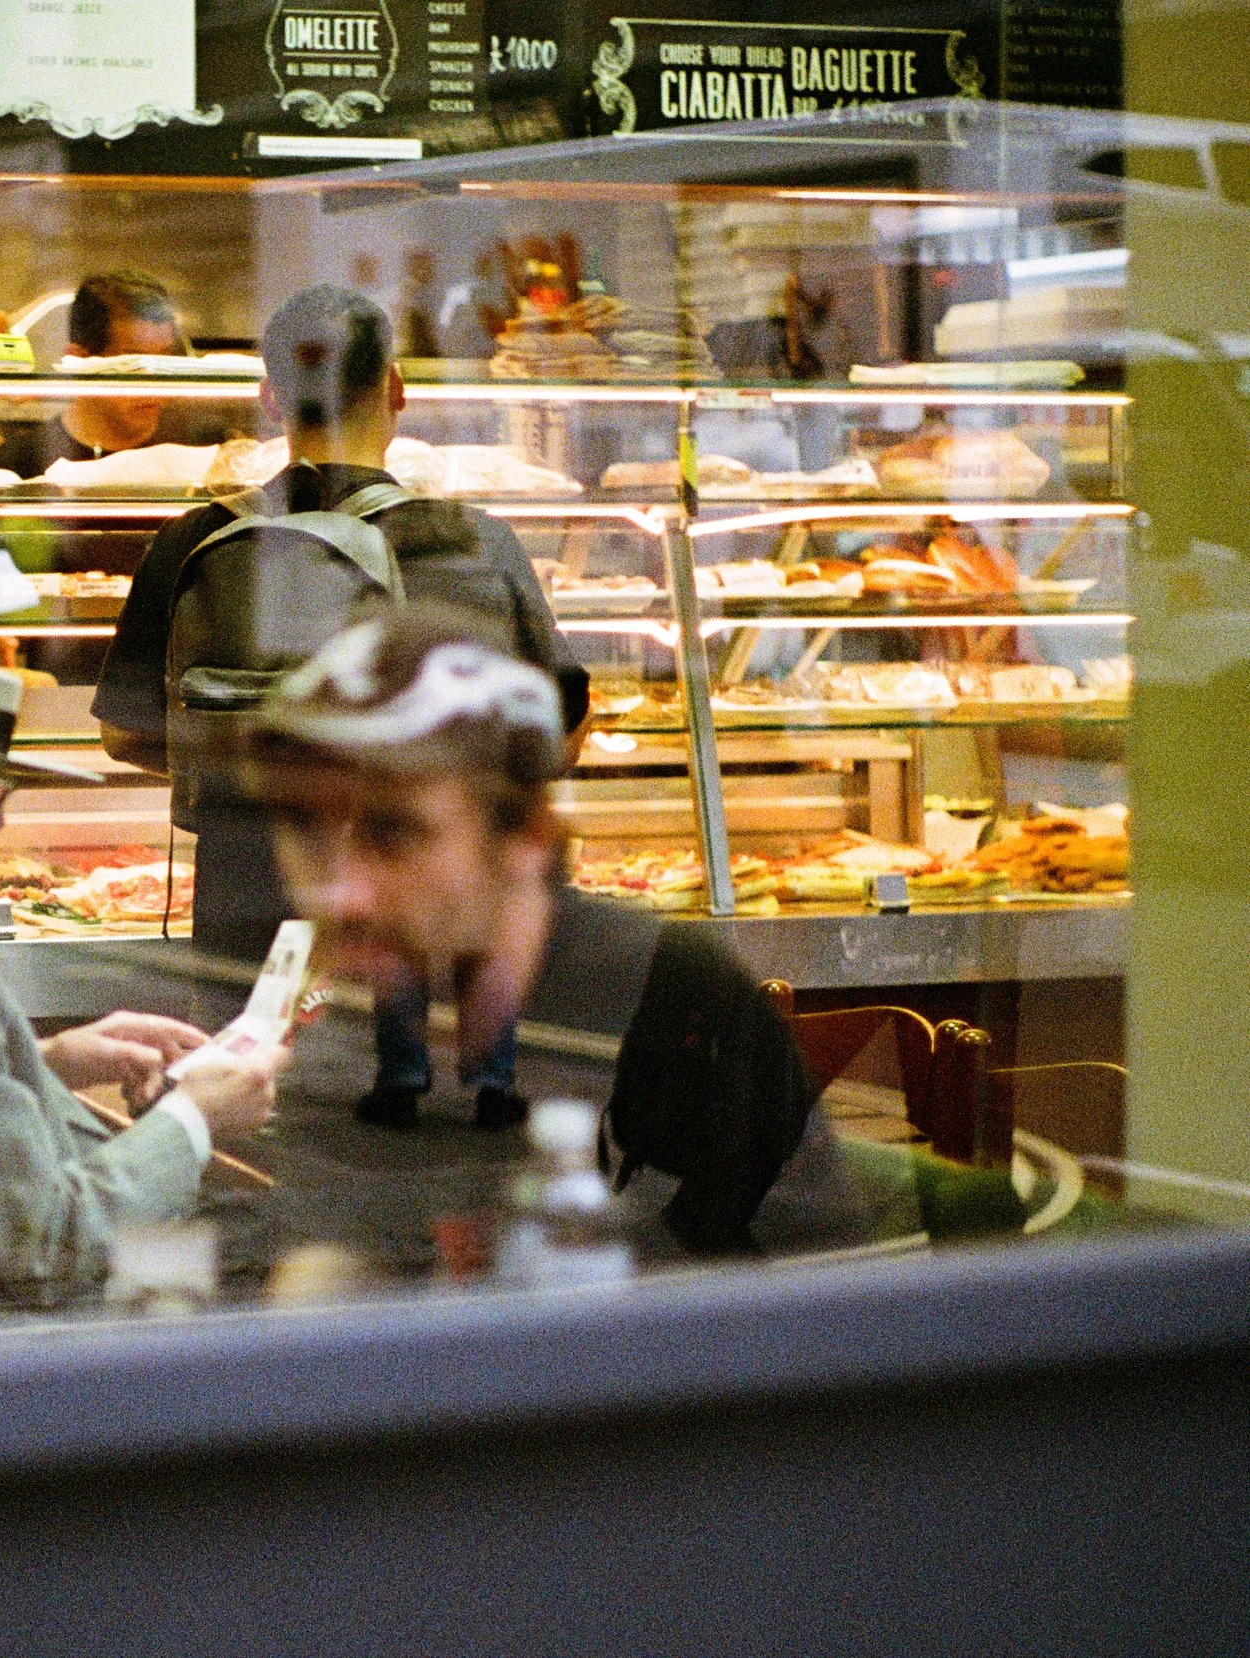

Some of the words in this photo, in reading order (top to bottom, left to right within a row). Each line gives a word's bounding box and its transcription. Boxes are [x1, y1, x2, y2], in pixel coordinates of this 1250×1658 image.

[284, 16, 379, 51] OMELETTE
[660, 43, 703, 65] CHOOSE
[709, 44, 741, 66] YOUR
[791, 46, 919, 94] BAGUETTE
[660, 70, 789, 120] CIABATTA
